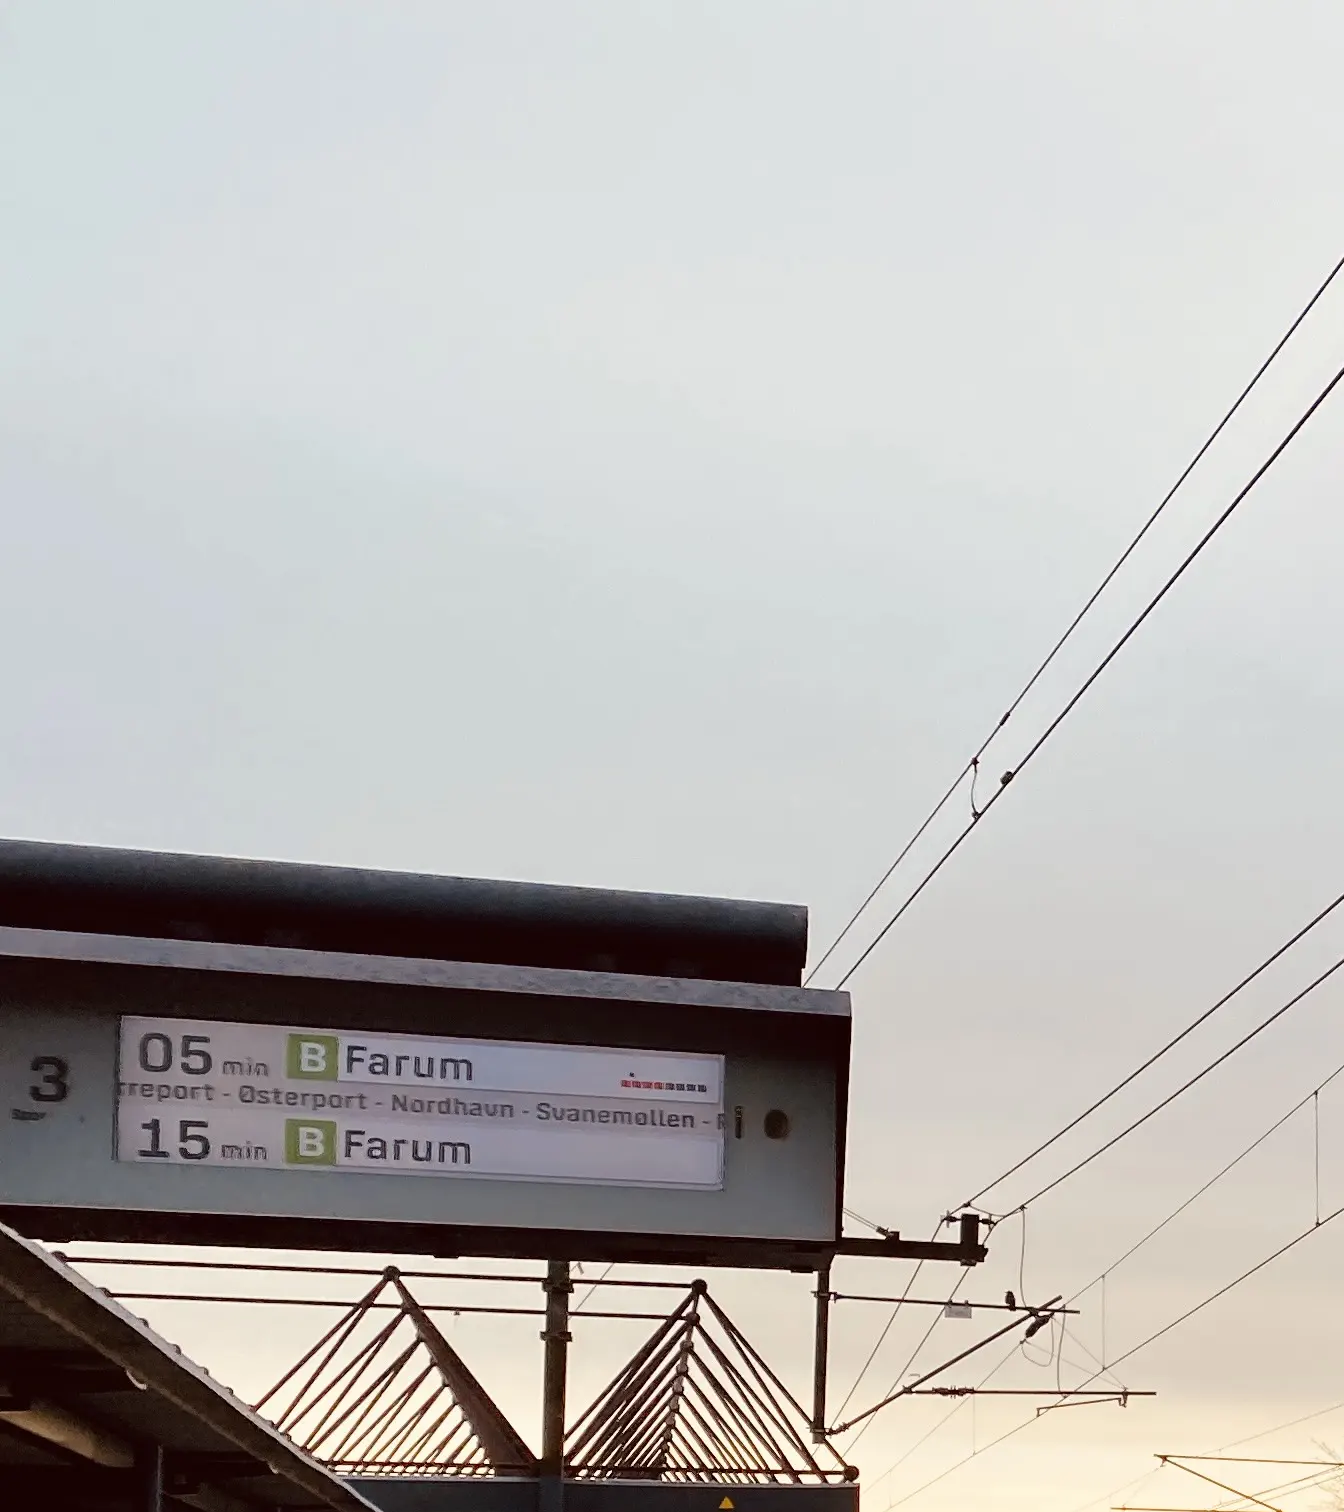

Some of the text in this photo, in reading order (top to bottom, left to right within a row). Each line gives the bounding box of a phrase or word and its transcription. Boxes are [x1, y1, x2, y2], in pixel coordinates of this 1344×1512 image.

[30, 1056, 69, 1102] 3
[139, 1032, 473, 1081] 05 min B Farum
[238, 1085, 367, 1110] Østerport
[391, 1094, 514, 1119] Nordhavn
[137, 1118, 471, 1165] 15 min B Farum
